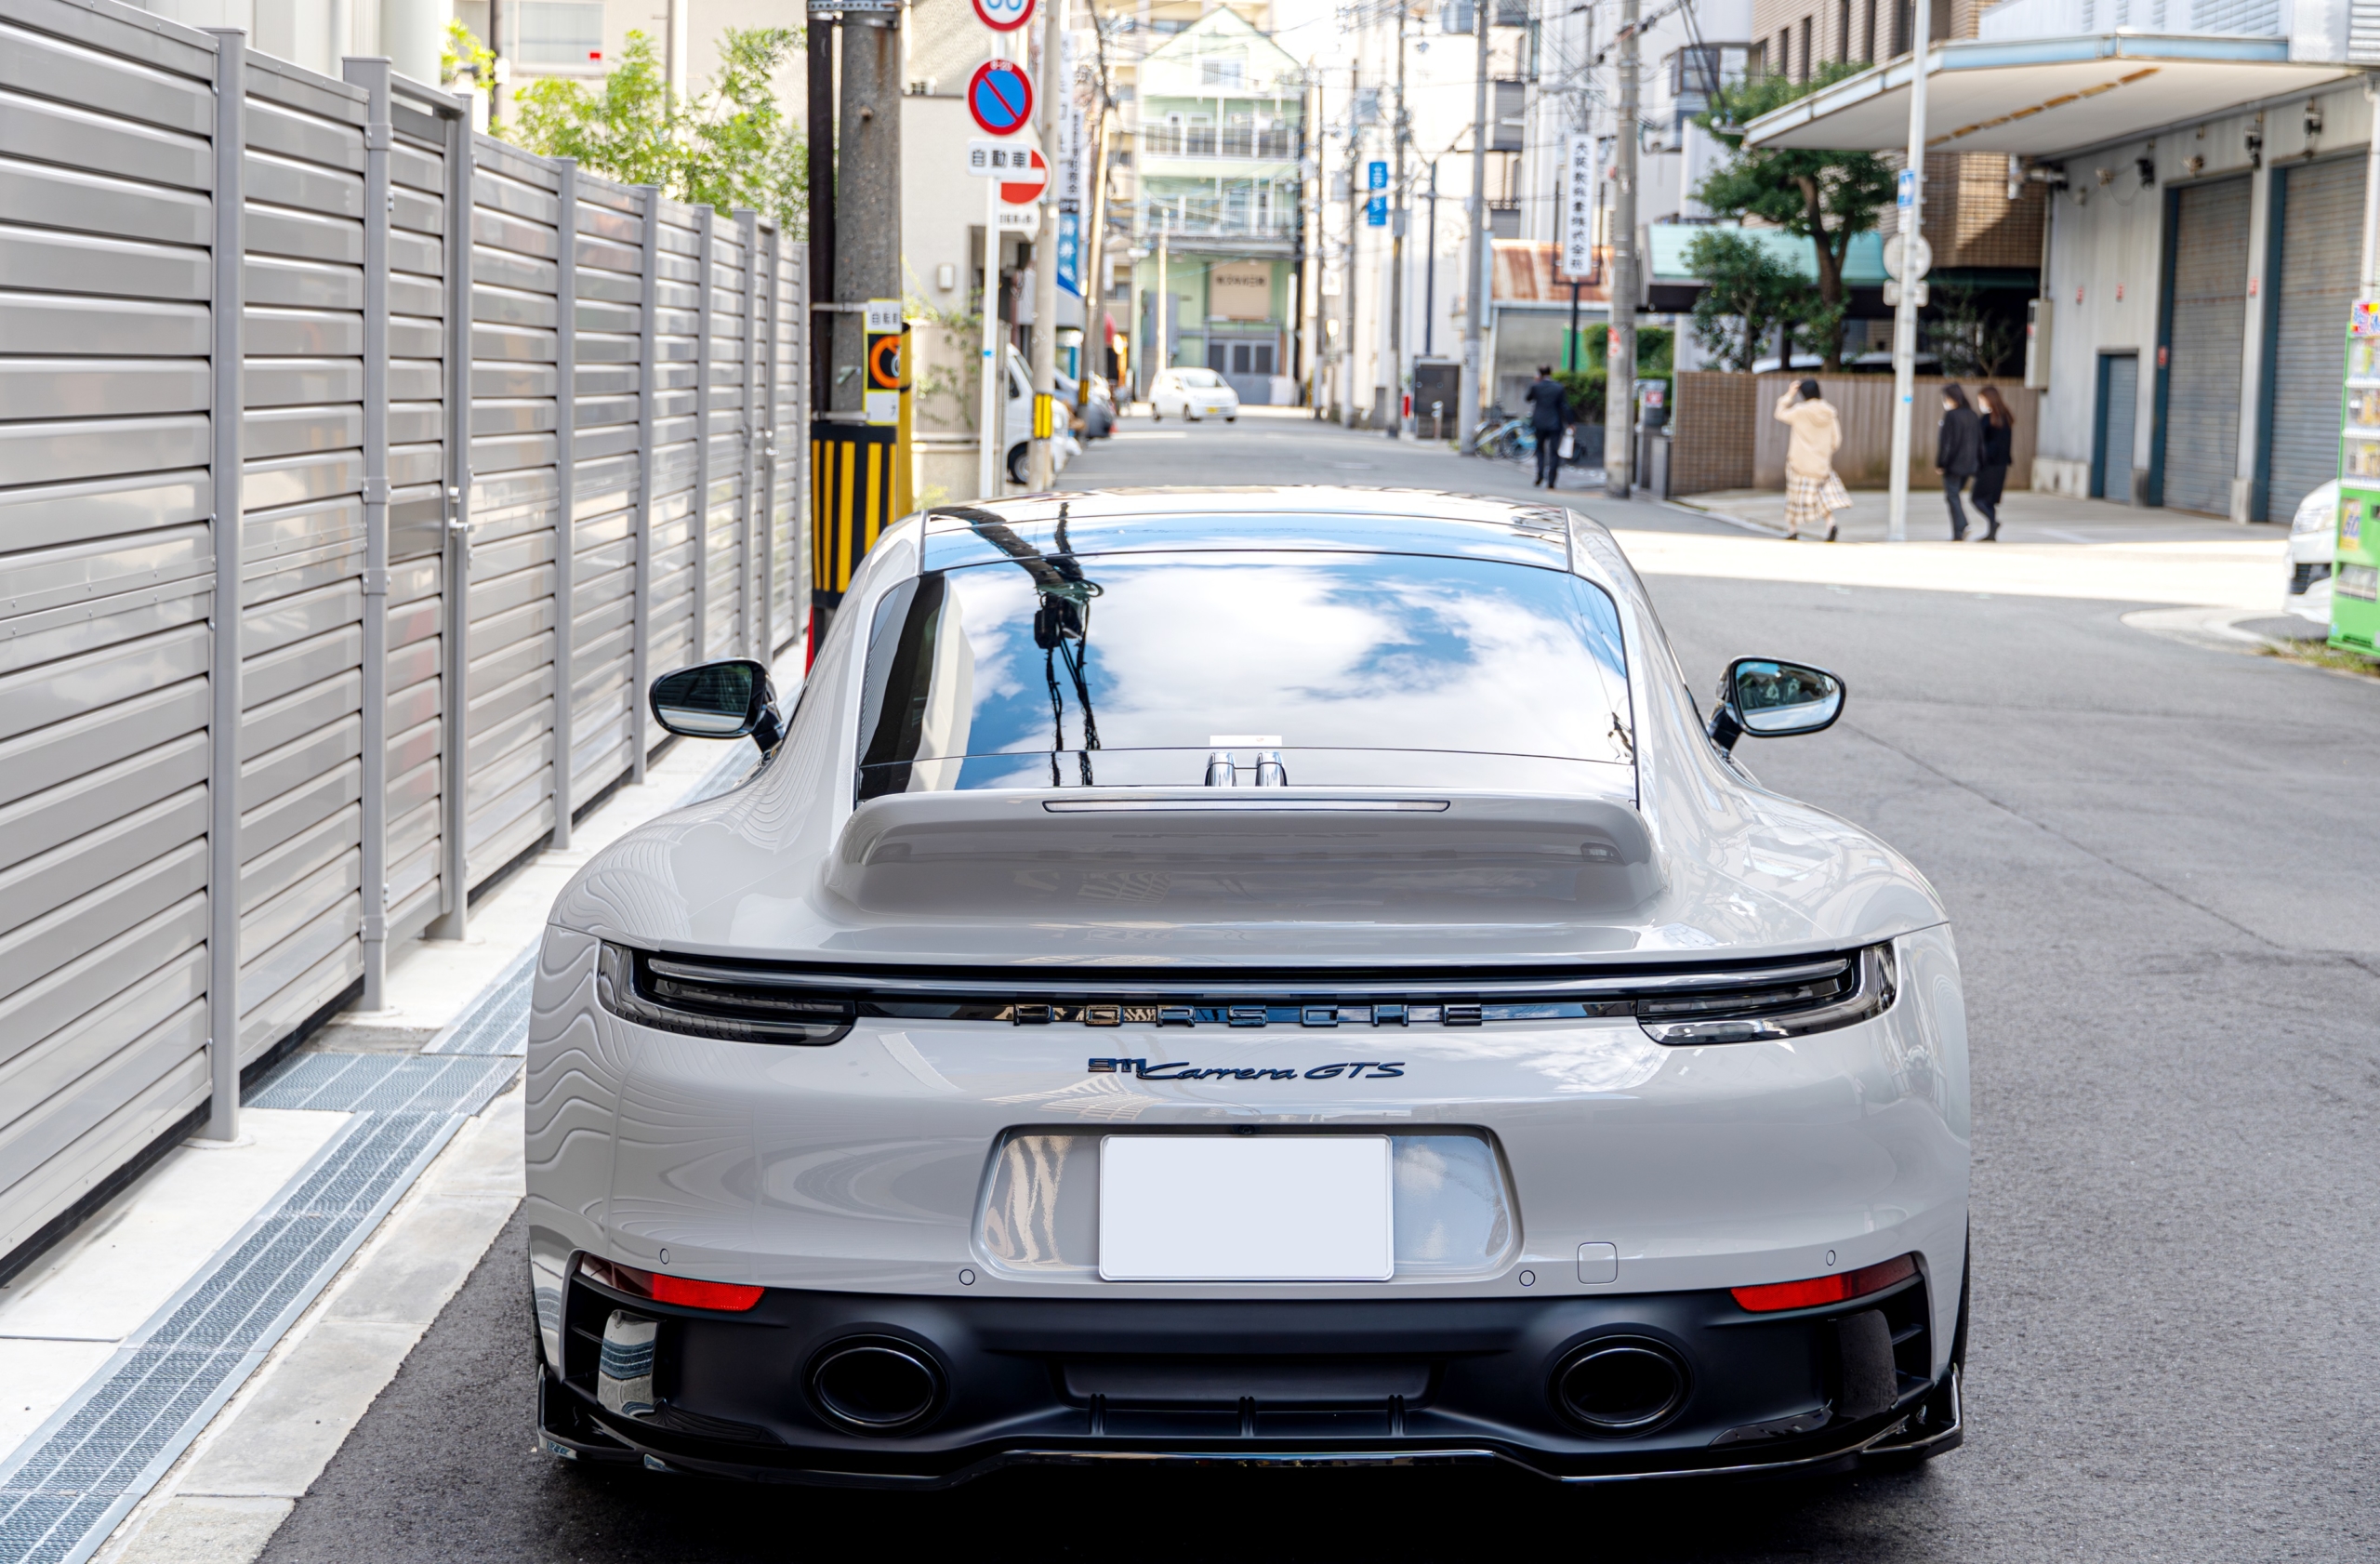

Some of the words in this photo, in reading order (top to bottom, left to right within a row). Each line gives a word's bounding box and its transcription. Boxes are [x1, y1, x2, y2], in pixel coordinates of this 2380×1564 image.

[972, 149, 1026, 169] 自動車
[1013, 1003, 1483, 1027] PORSCHE
[1088, 1058, 1146, 1072] 911
[1136, 1061, 1298, 1080] Carrera
[1304, 1061, 1406, 1080] GTS
